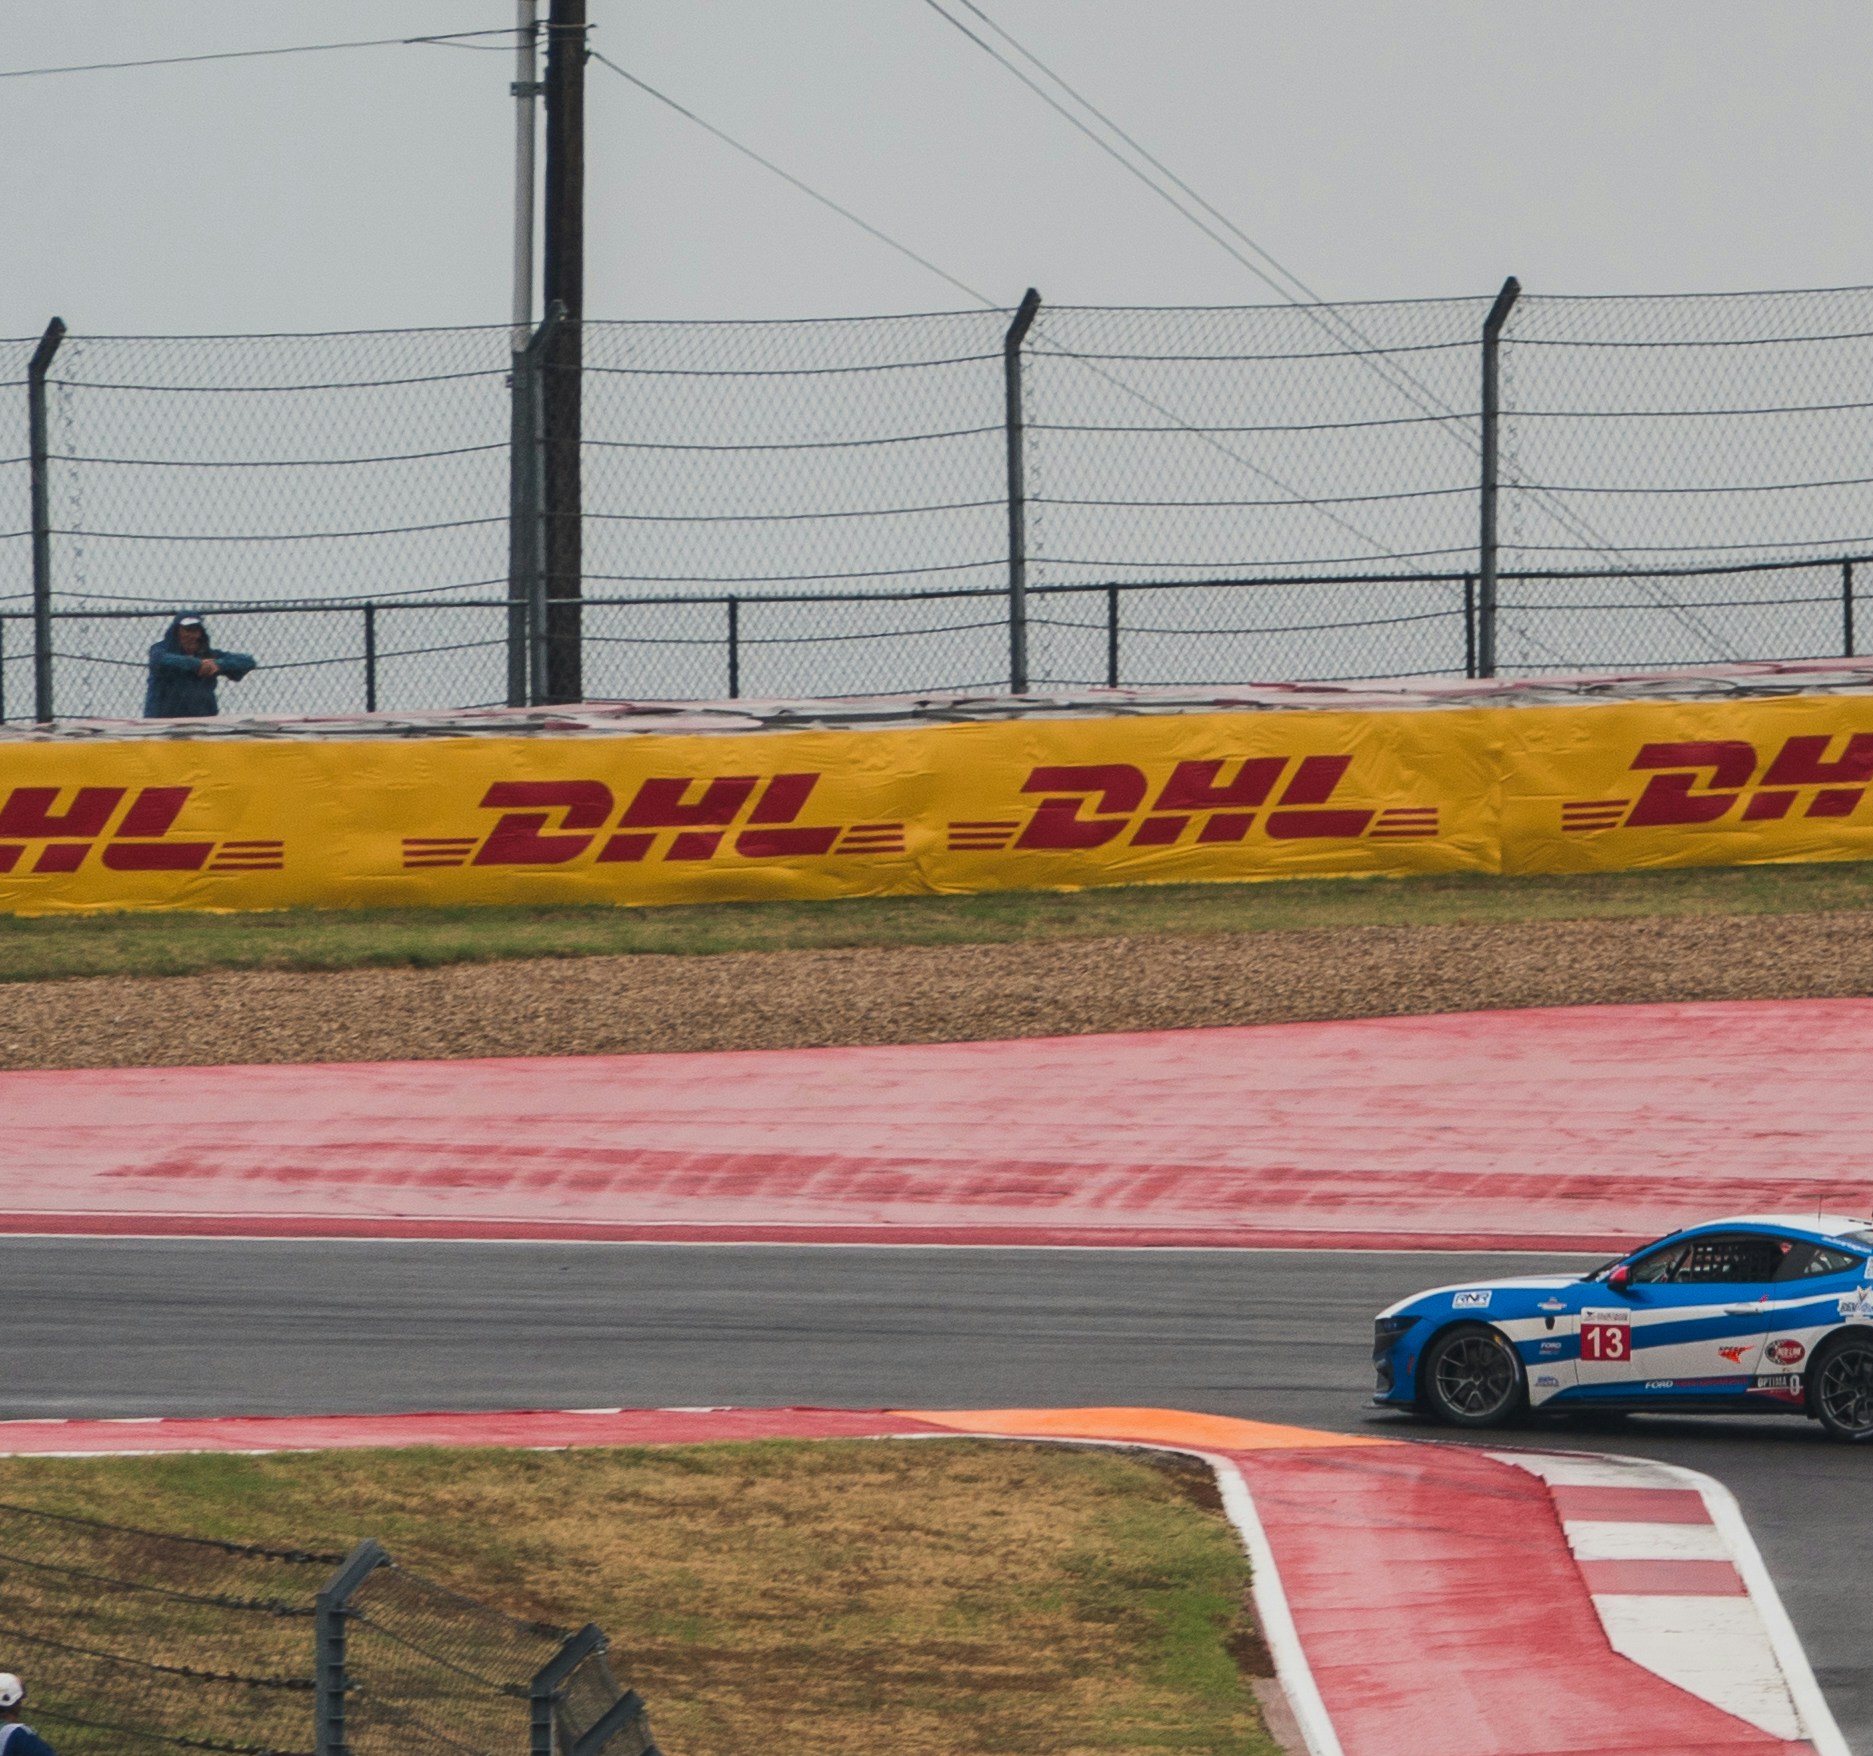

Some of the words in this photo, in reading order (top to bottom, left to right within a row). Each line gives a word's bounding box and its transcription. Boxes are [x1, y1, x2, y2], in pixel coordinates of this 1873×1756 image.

[1014, 755, 1374, 851] DHL
[474, 773, 841, 866] DHL
[1588, 1327, 1624, 1358] 13
[1645, 1380, 1674, 1389] FORD
[1757, 1376, 1787, 1388] OPTIMA
